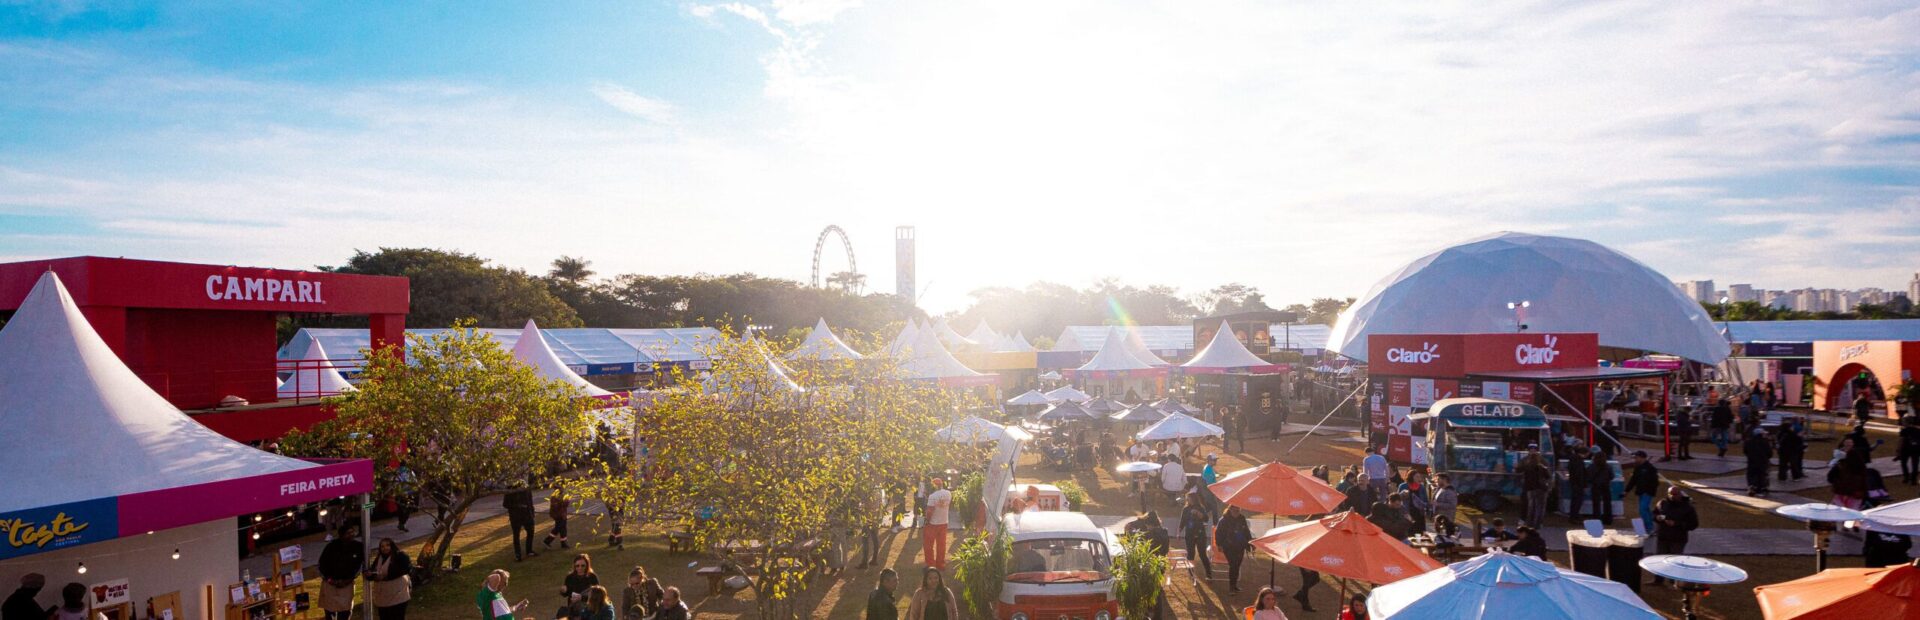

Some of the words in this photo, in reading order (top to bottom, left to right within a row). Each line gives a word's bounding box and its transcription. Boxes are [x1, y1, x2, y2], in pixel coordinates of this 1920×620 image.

[206, 274, 322, 304] CAMPARI
[1386, 347, 1433, 364] Claro
[1515, 343, 1554, 365] Claro
[1462, 404, 1524, 417] GELATO
[280, 480, 317, 496] FEIRA
[319, 473, 355, 489] PRETA
